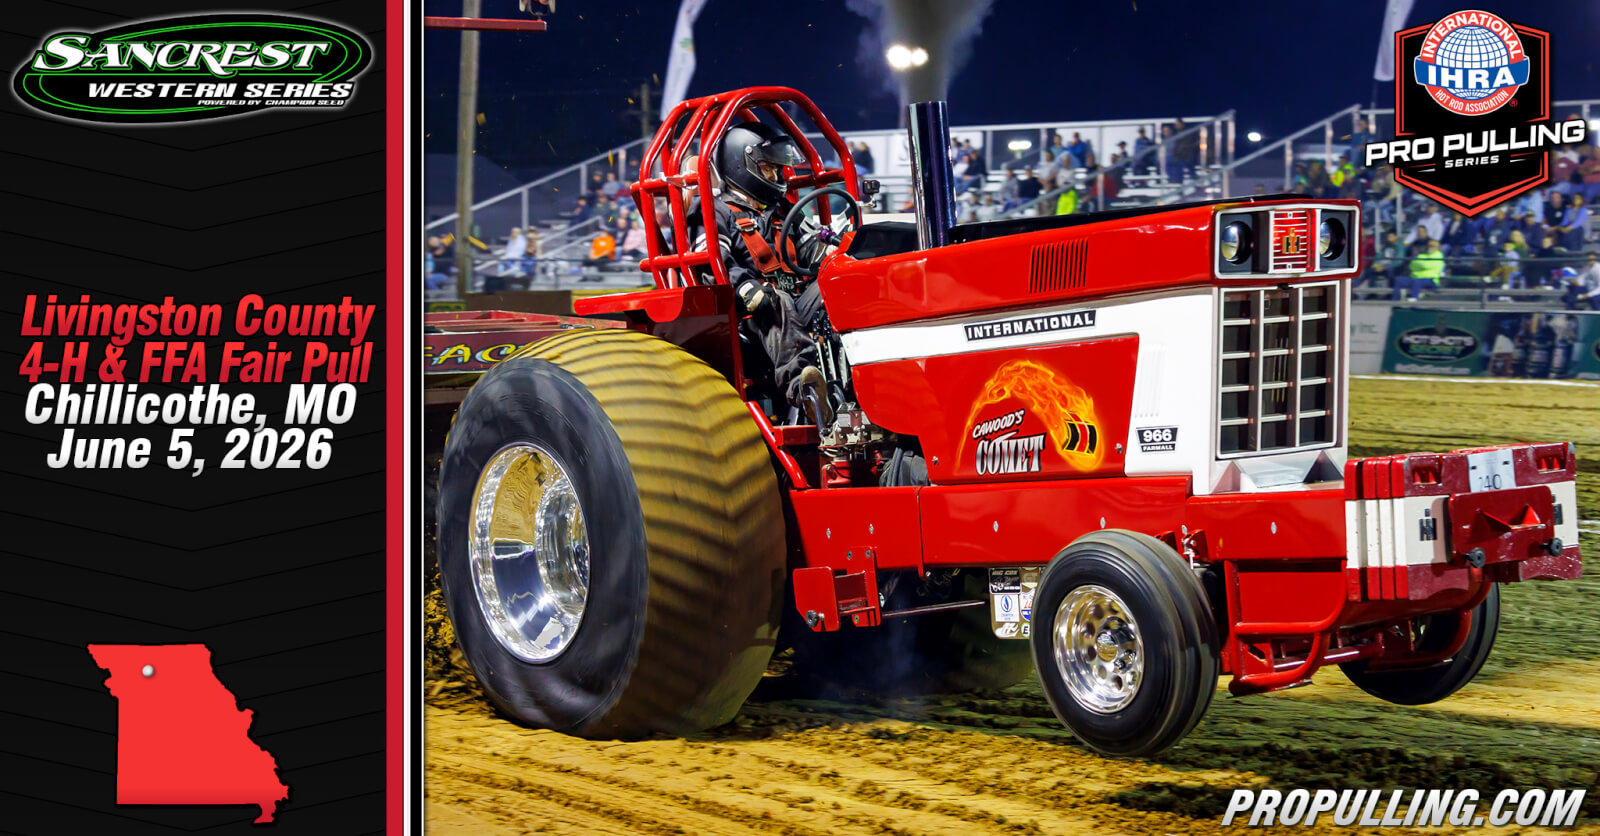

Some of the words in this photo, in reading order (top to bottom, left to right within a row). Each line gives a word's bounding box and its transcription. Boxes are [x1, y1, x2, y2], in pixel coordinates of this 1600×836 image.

[967, 311, 1094, 339] INTERNATIONAL
[972, 409, 1025, 439] CAWOOD'S
[1143, 429, 1172, 442] 966
[975, 430, 1045, 475] COMET
